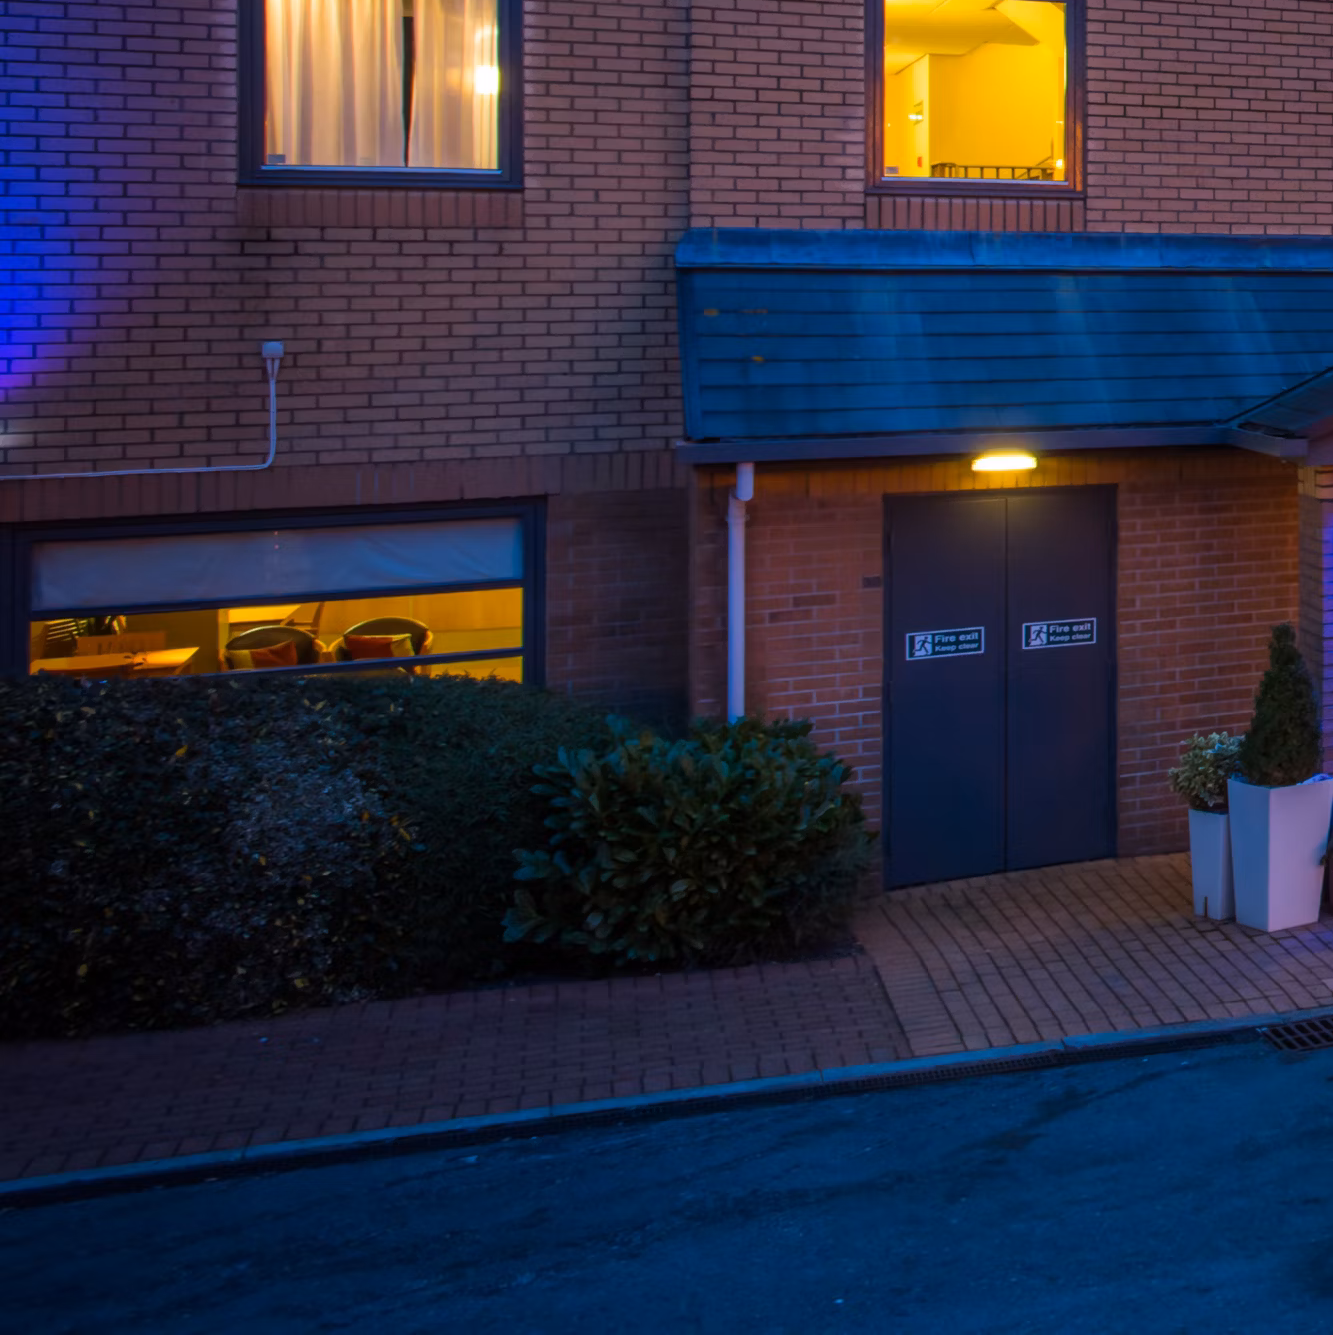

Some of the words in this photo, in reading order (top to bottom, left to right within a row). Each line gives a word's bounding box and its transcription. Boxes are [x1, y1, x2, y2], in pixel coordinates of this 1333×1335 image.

[1049, 625, 1070, 634] Fire
[1072, 623, 1091, 632] exit
[935, 635, 956, 644] Fire
[959, 632, 979, 641] exit
